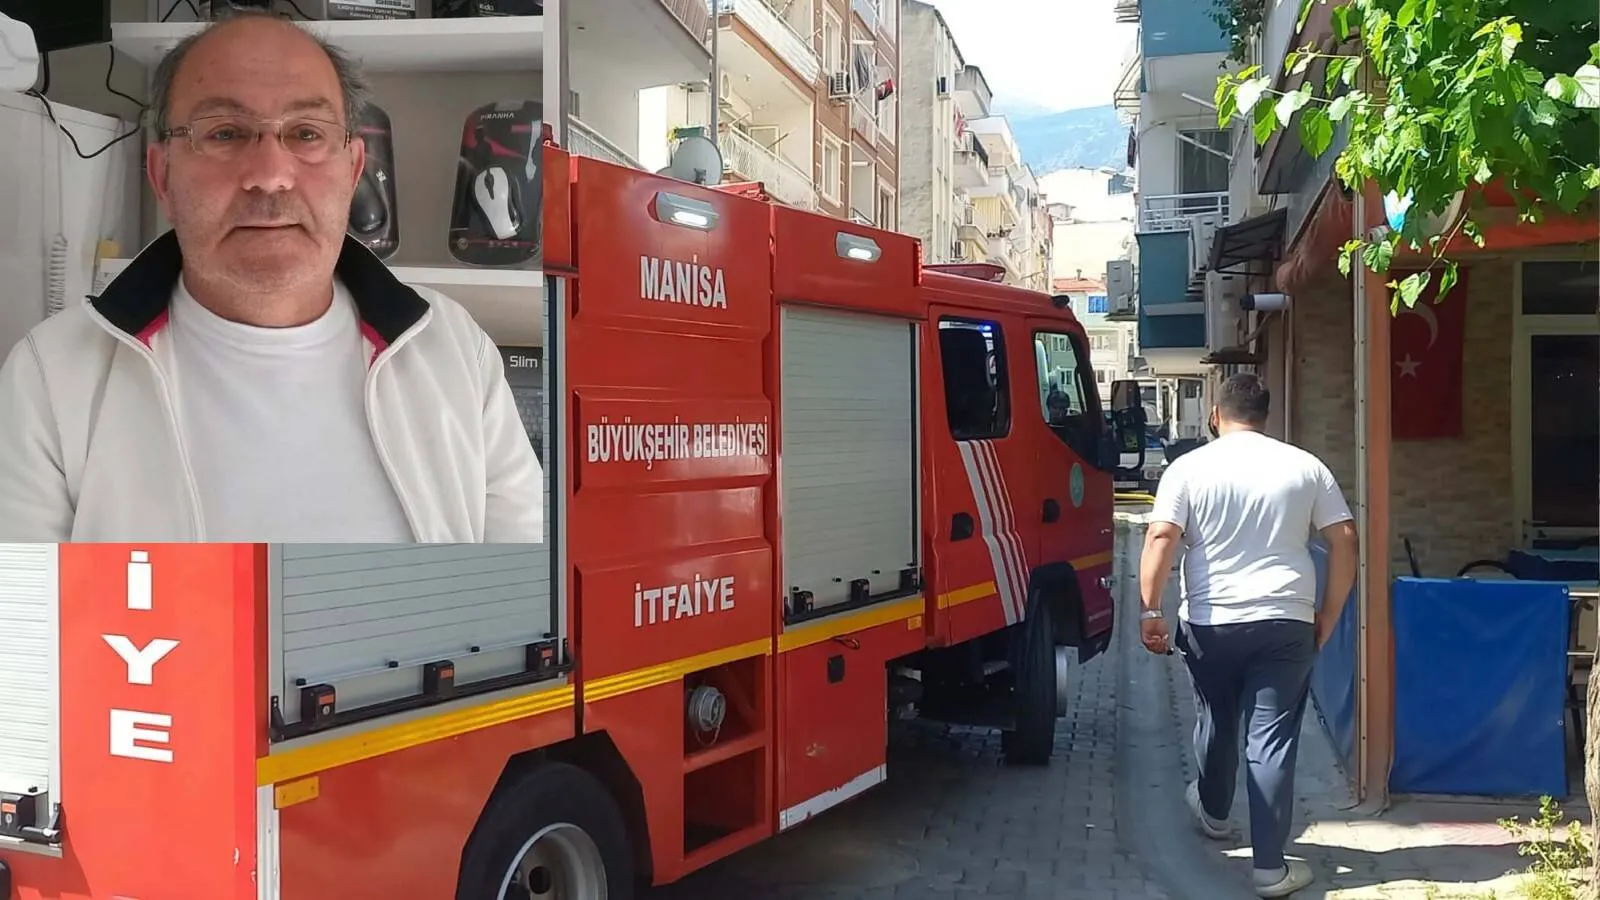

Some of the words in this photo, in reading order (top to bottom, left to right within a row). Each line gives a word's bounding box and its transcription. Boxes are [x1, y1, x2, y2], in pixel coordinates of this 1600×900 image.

[480, 112, 515, 120] PIRANHA
[640, 254, 728, 309] MANİSA
[509, 355, 538, 368] Slim
[587, 415, 690, 470] BÜYÜKŞEHİR
[693, 415, 768, 458] BELEDİYESİ
[634, 573, 735, 627] İTFAİYE
